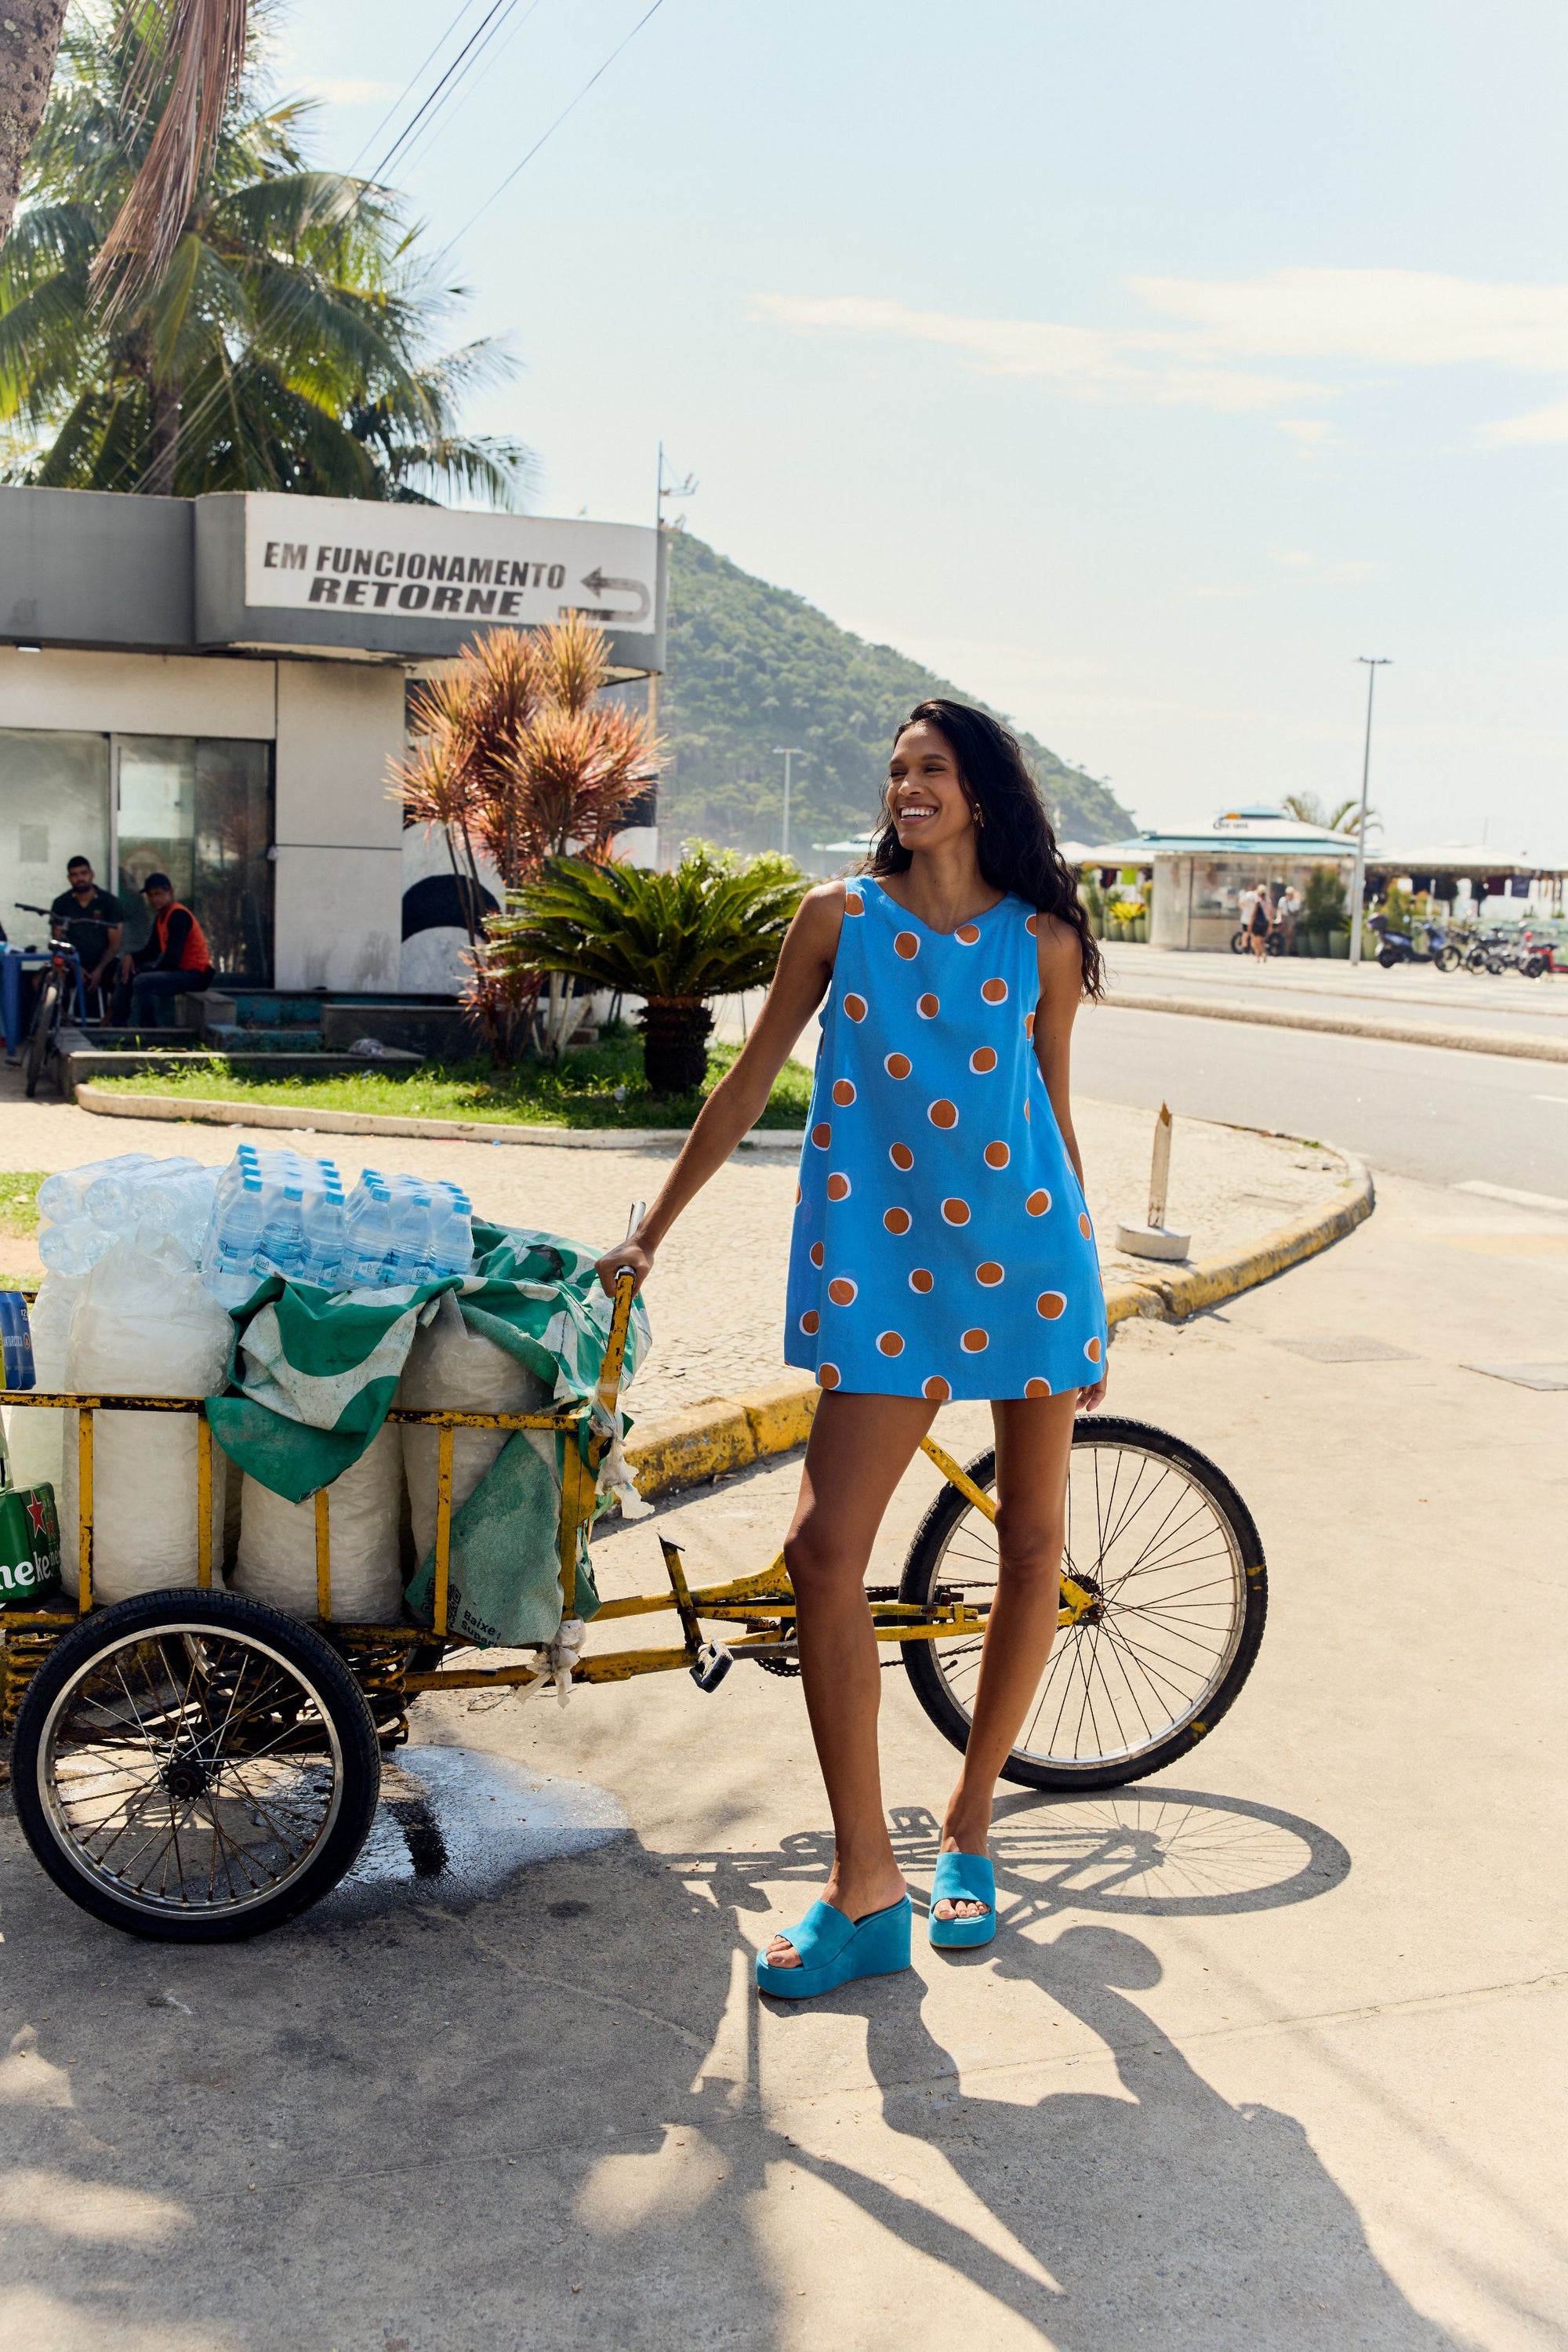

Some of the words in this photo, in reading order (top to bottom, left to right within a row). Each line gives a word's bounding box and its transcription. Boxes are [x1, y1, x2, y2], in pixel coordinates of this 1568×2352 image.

[263, 542, 308, 570] EM
[316, 546, 567, 590] FUNCIONAMENTO
[309, 577, 523, 616] RETORNE
[464, 1610, 496, 1635] Baixe
